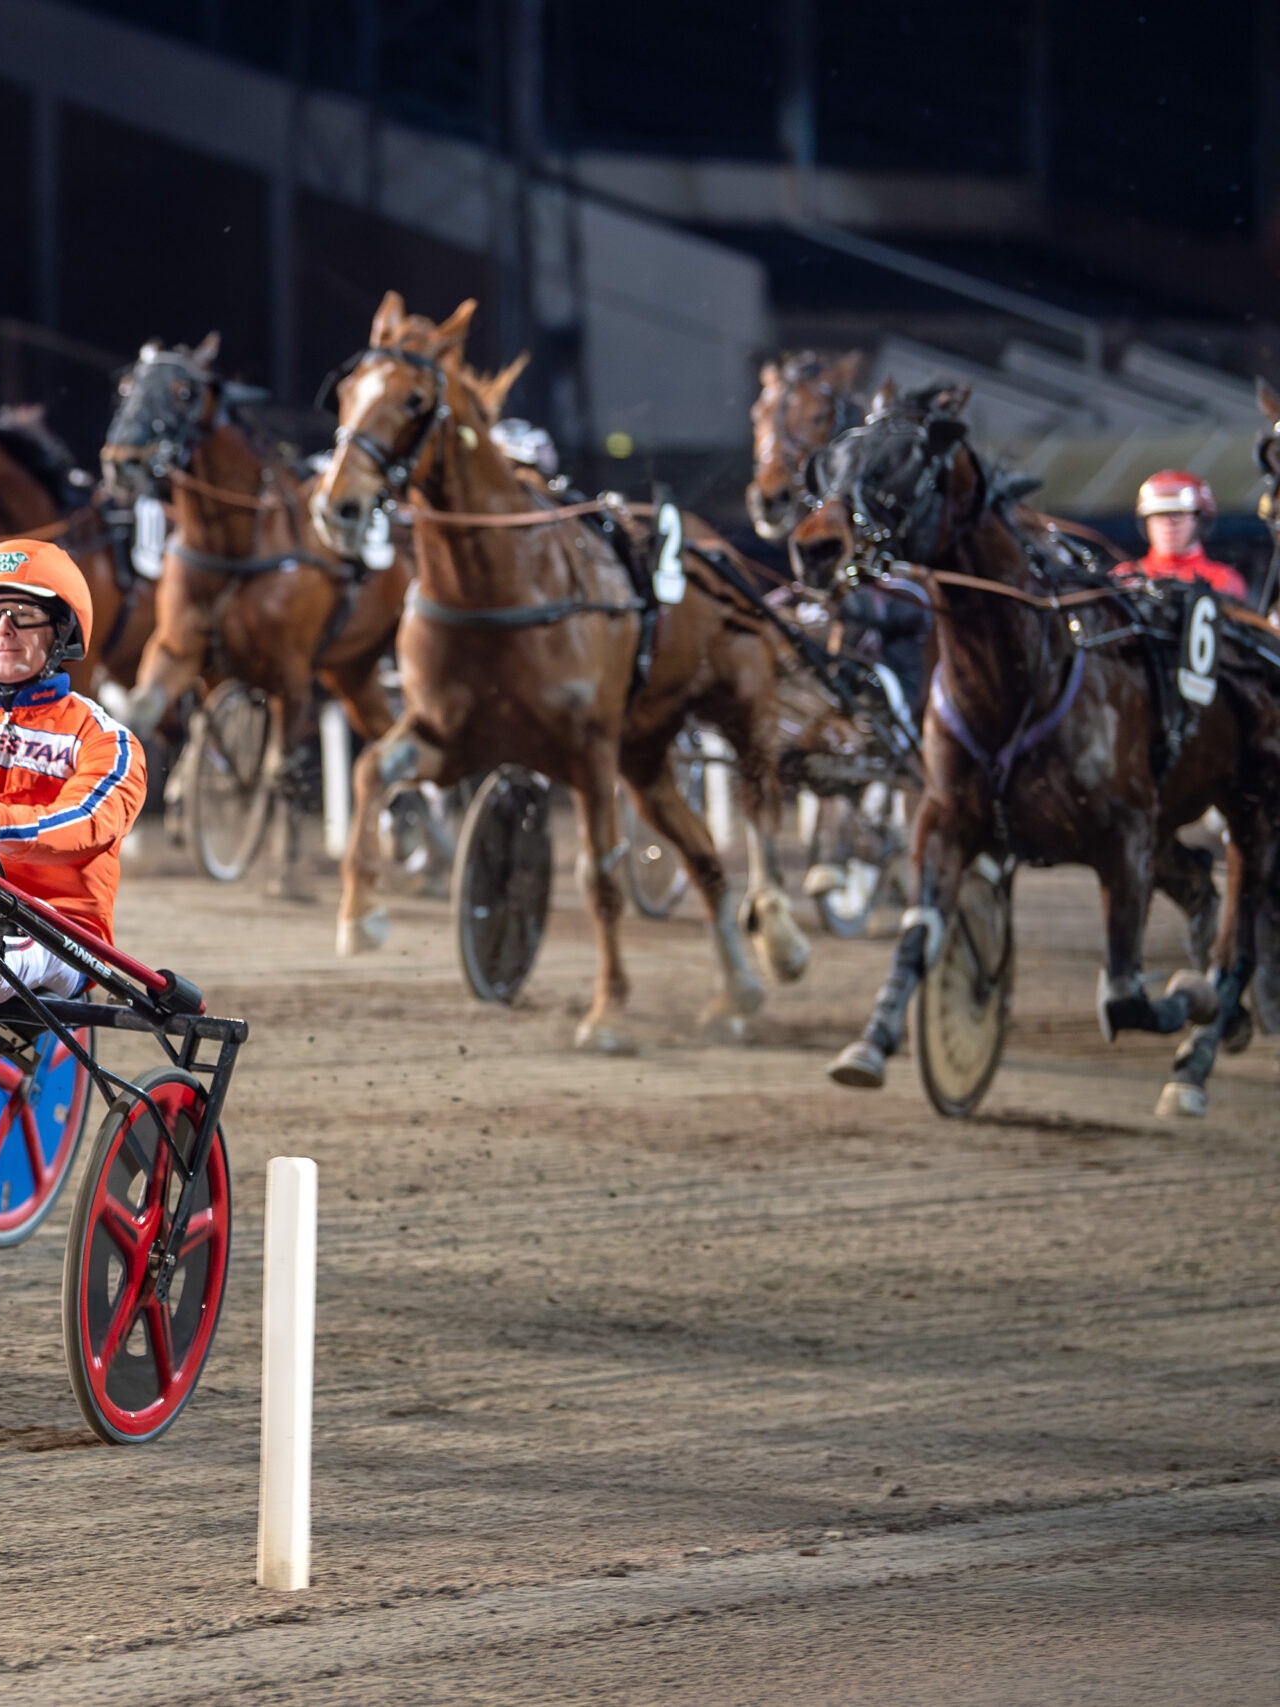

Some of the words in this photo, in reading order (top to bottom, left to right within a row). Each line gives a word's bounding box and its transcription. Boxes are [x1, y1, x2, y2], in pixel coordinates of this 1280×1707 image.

[659, 502, 682, 574] 2
[1189, 597, 1217, 675] 6
[63, 935, 112, 979] YANKEE
